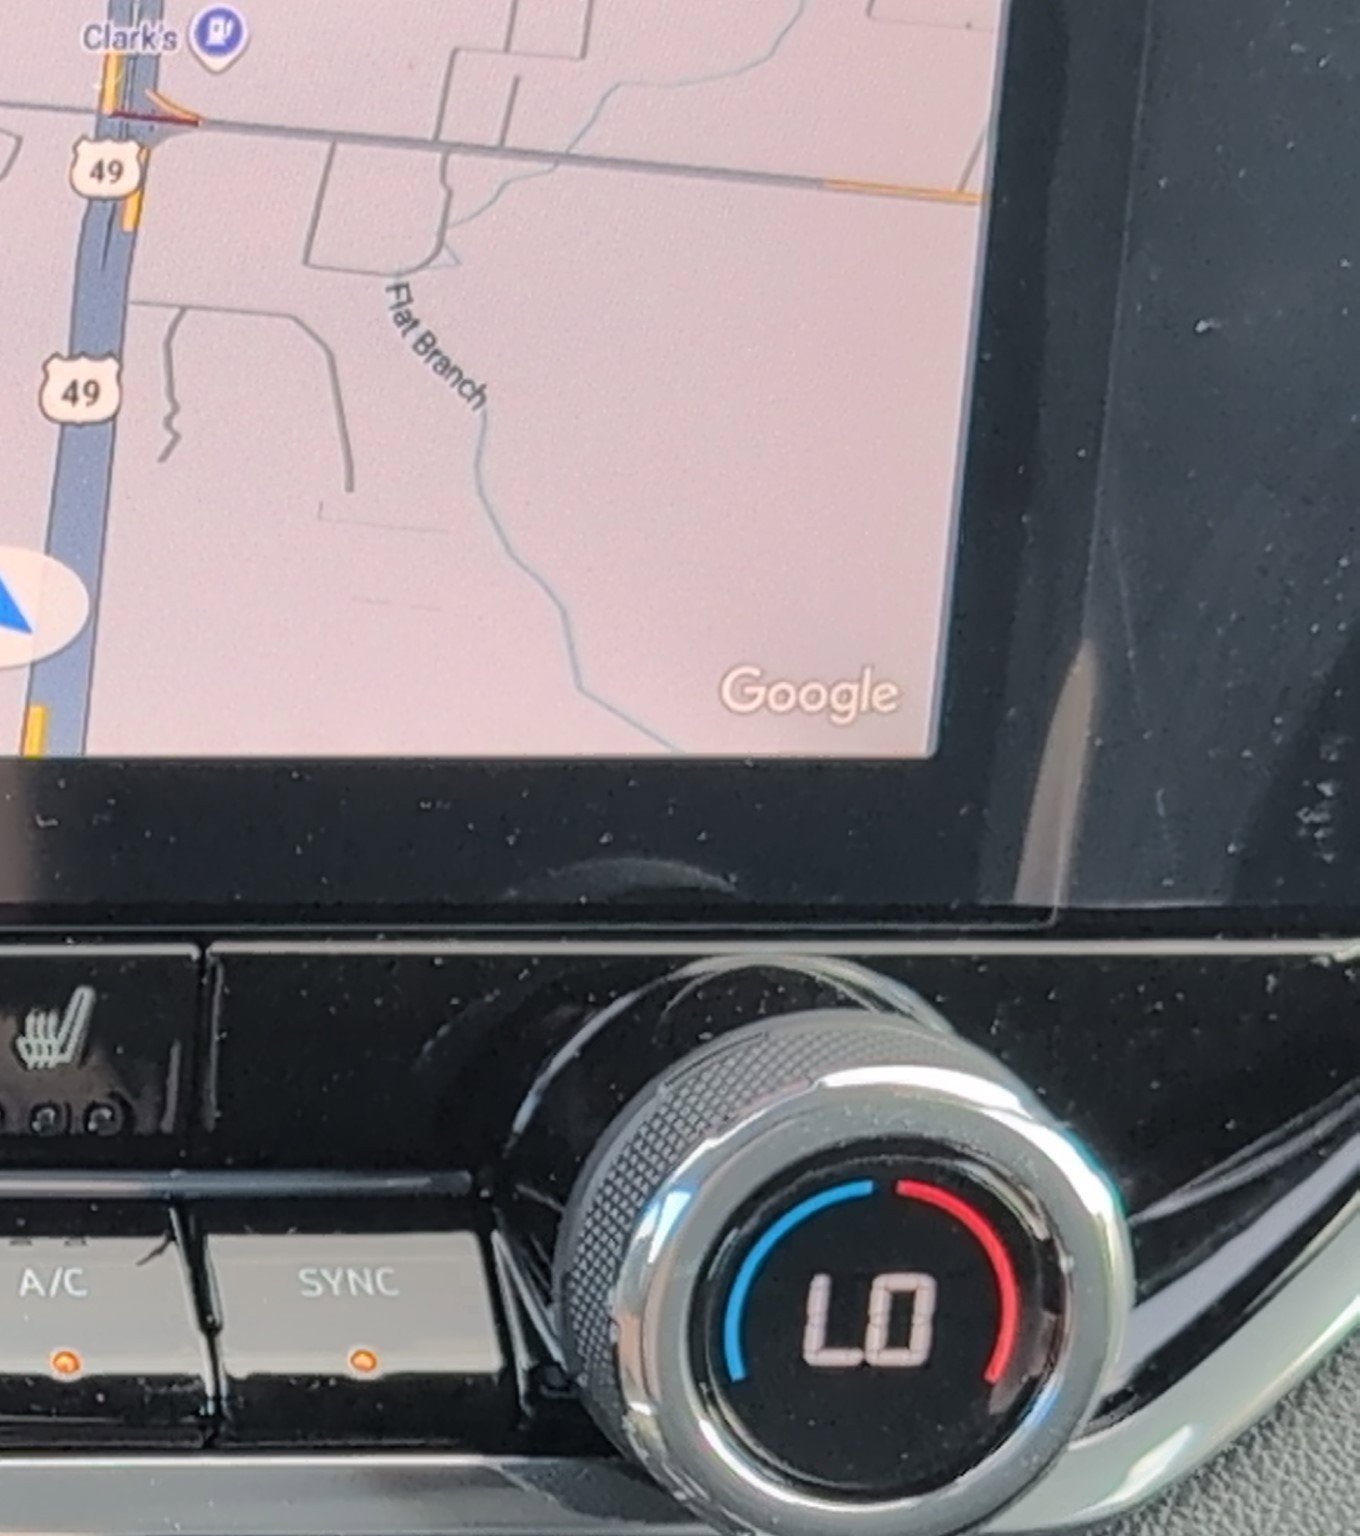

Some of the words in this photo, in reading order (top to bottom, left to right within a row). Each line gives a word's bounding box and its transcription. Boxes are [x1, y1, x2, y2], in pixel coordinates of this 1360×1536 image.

[83, 23, 178, 50] Clark's
[89, 159, 124, 183] 49
[385, 281, 420, 338] Flat
[412, 330, 487, 411] Branch
[61, 379, 100, 407] 49
[720, 665, 899, 726] Google
[19, 1267, 88, 1298] A/C
[299, 1267, 400, 1297] SYNC
[803, 1273, 937, 1367] LO
